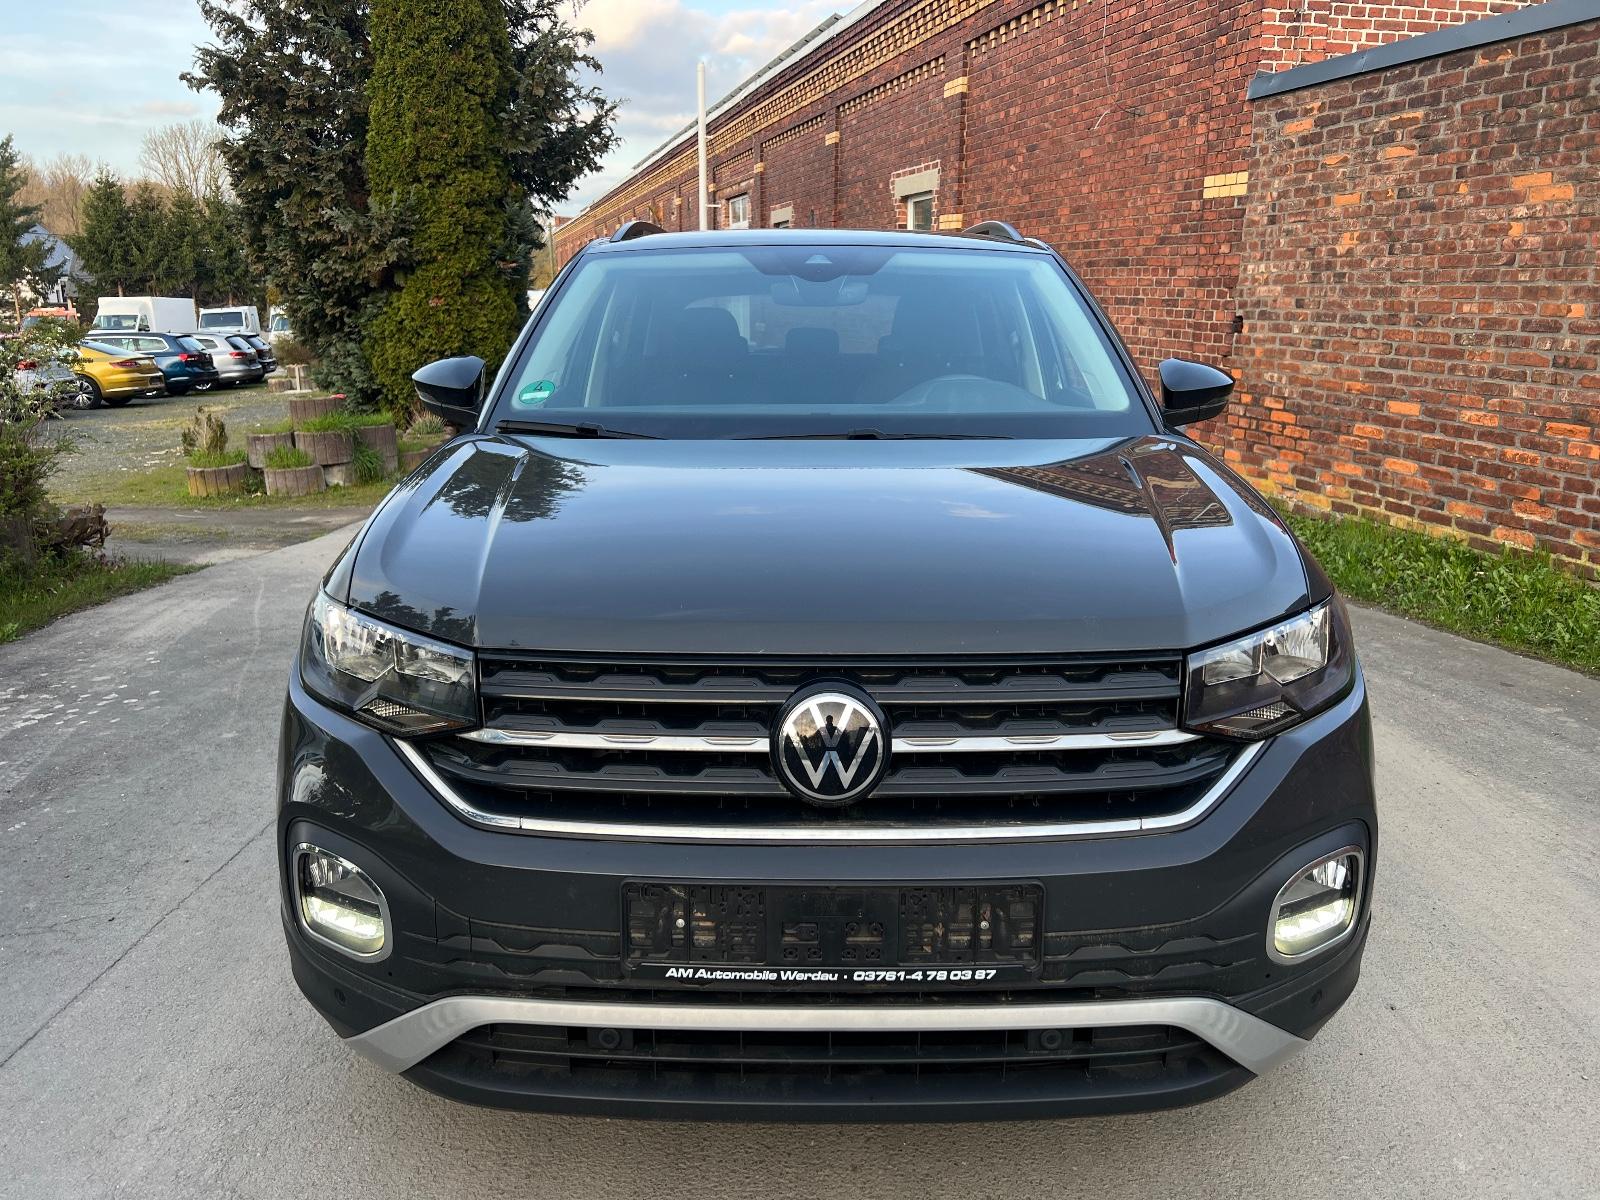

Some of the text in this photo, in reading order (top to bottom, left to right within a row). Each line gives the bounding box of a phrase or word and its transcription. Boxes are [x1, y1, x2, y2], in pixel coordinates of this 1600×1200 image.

[534, 381, 543, 391] 4
[782, 693, 881, 797] VW
[665, 967, 997, 982] AM Automobile Werdau 03761-4 78 03 87
